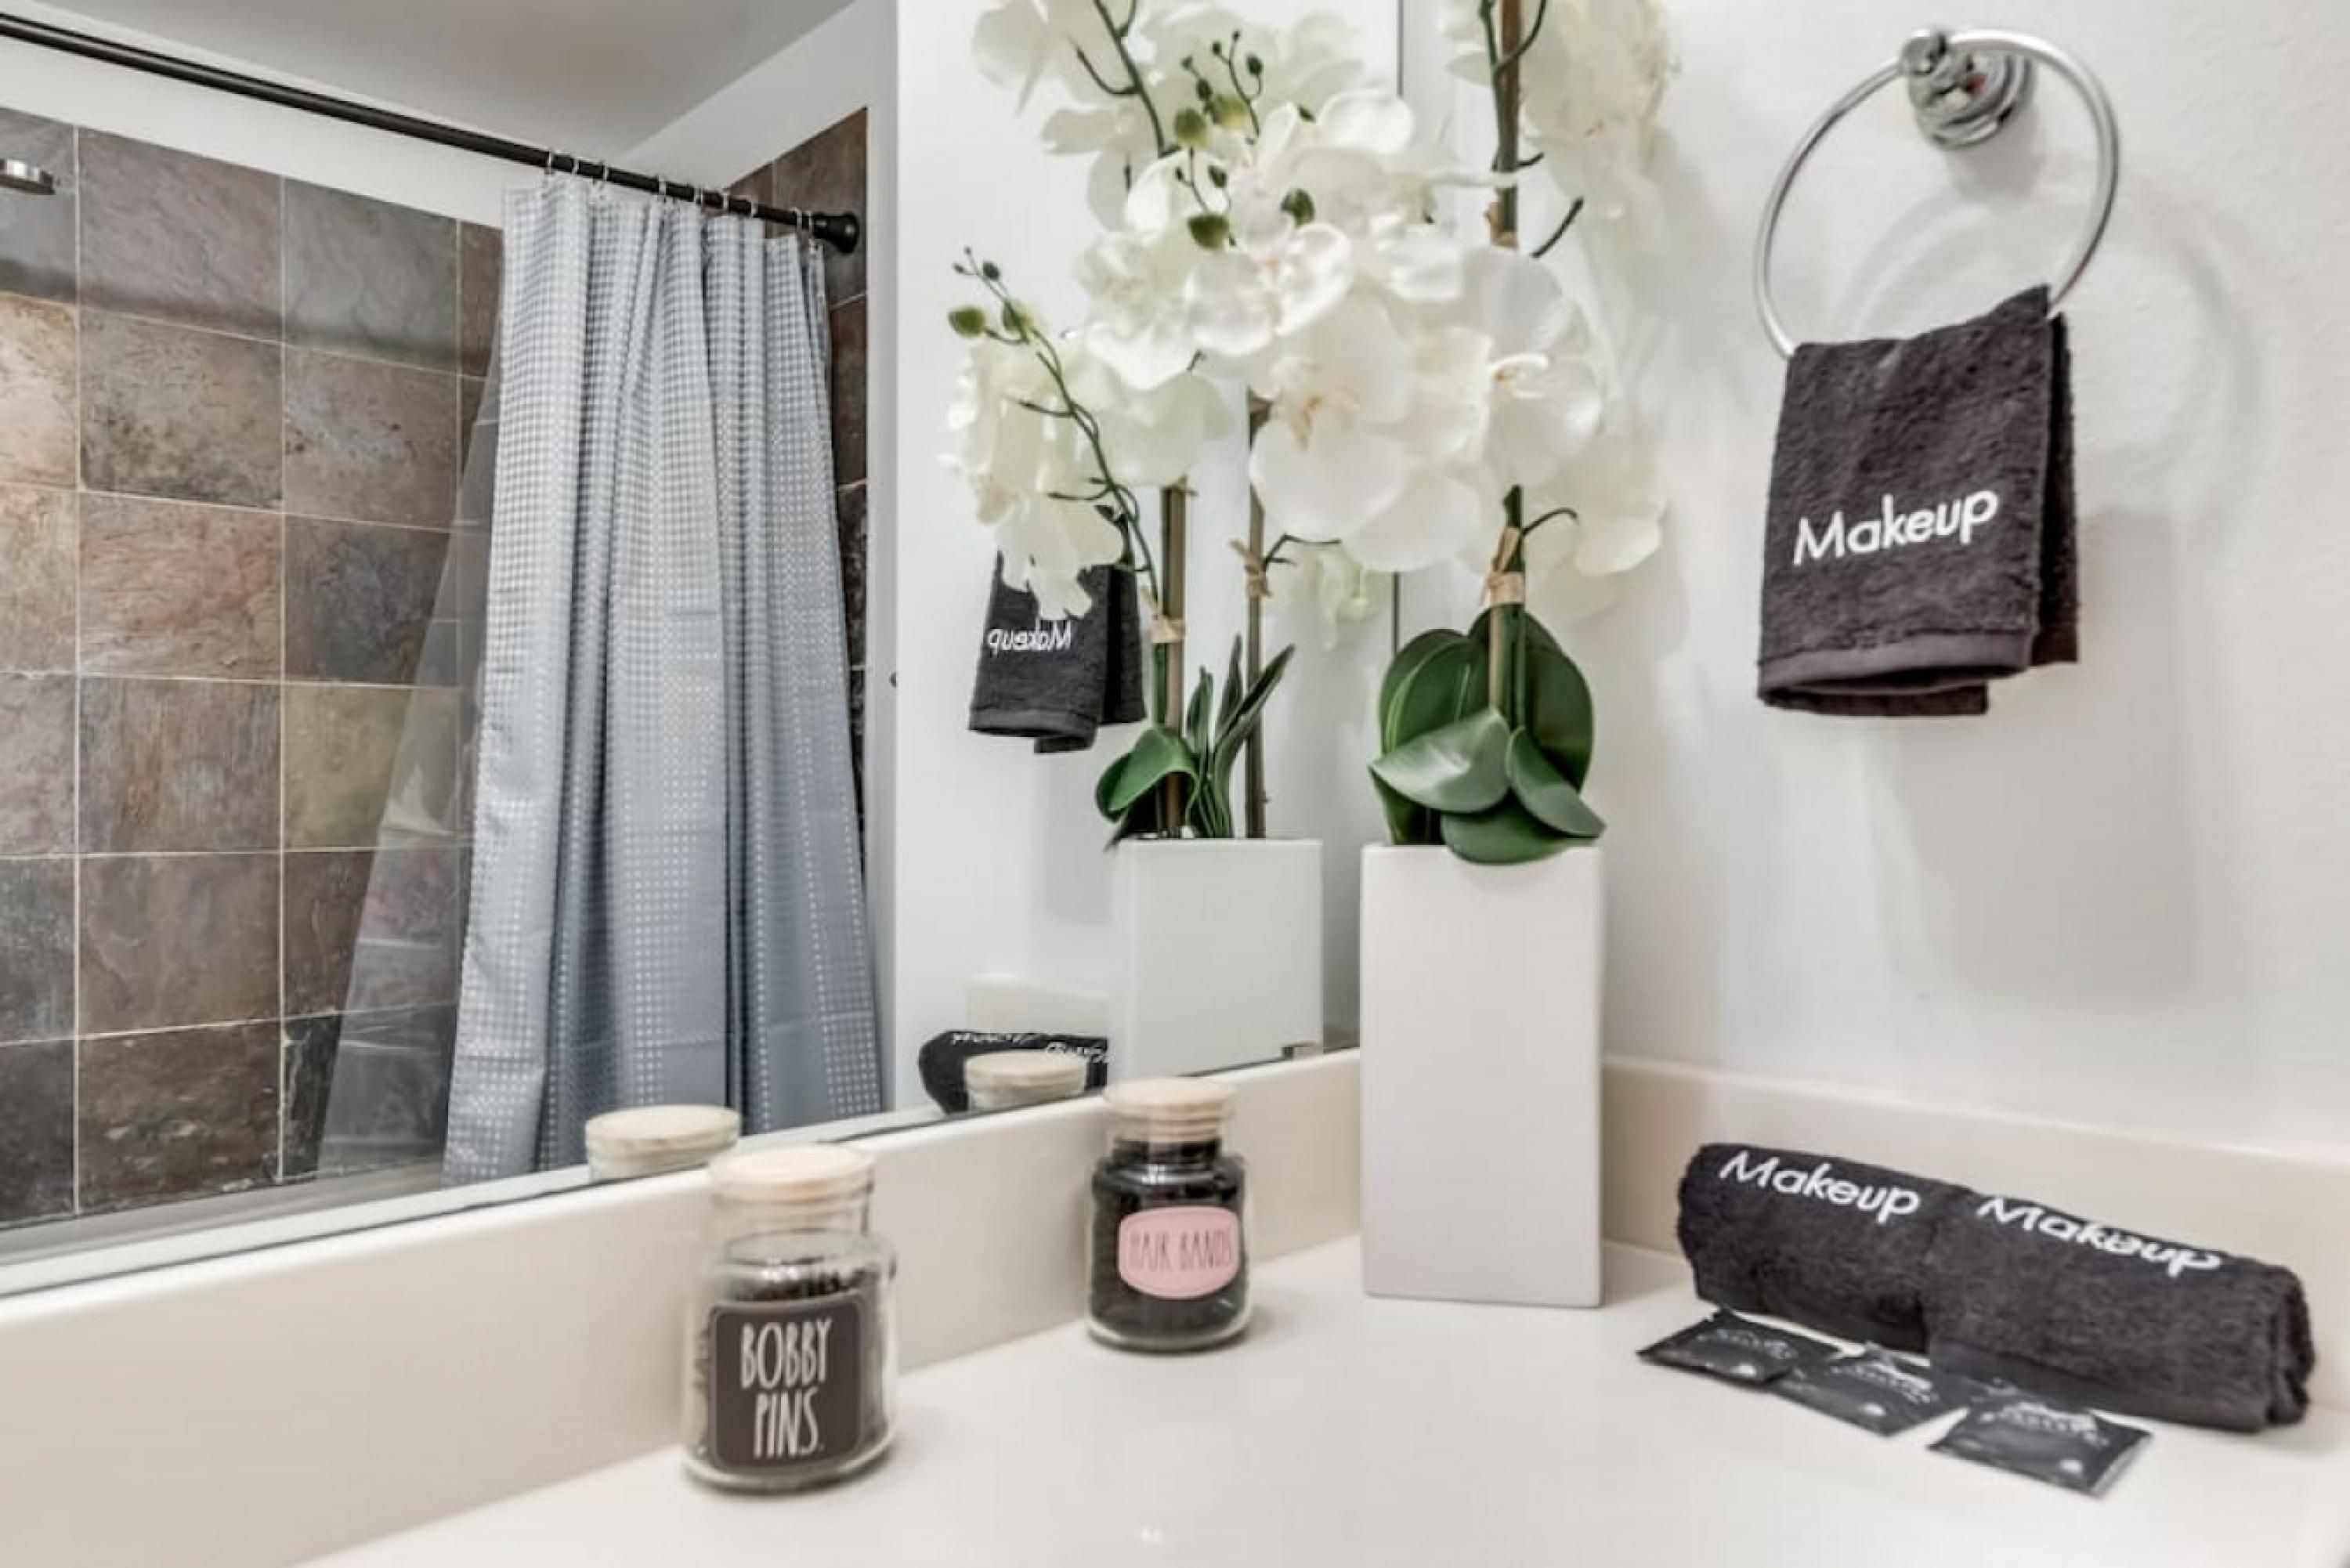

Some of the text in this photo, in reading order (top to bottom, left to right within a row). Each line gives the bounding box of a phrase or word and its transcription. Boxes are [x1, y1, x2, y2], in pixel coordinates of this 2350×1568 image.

[1793, 490, 1998, 565] Makeup
[1719, 1151, 1921, 1223] Makeup
[1976, 1197, 2222, 1277] Makeup
[740, 1317, 833, 1389] BOBBY
